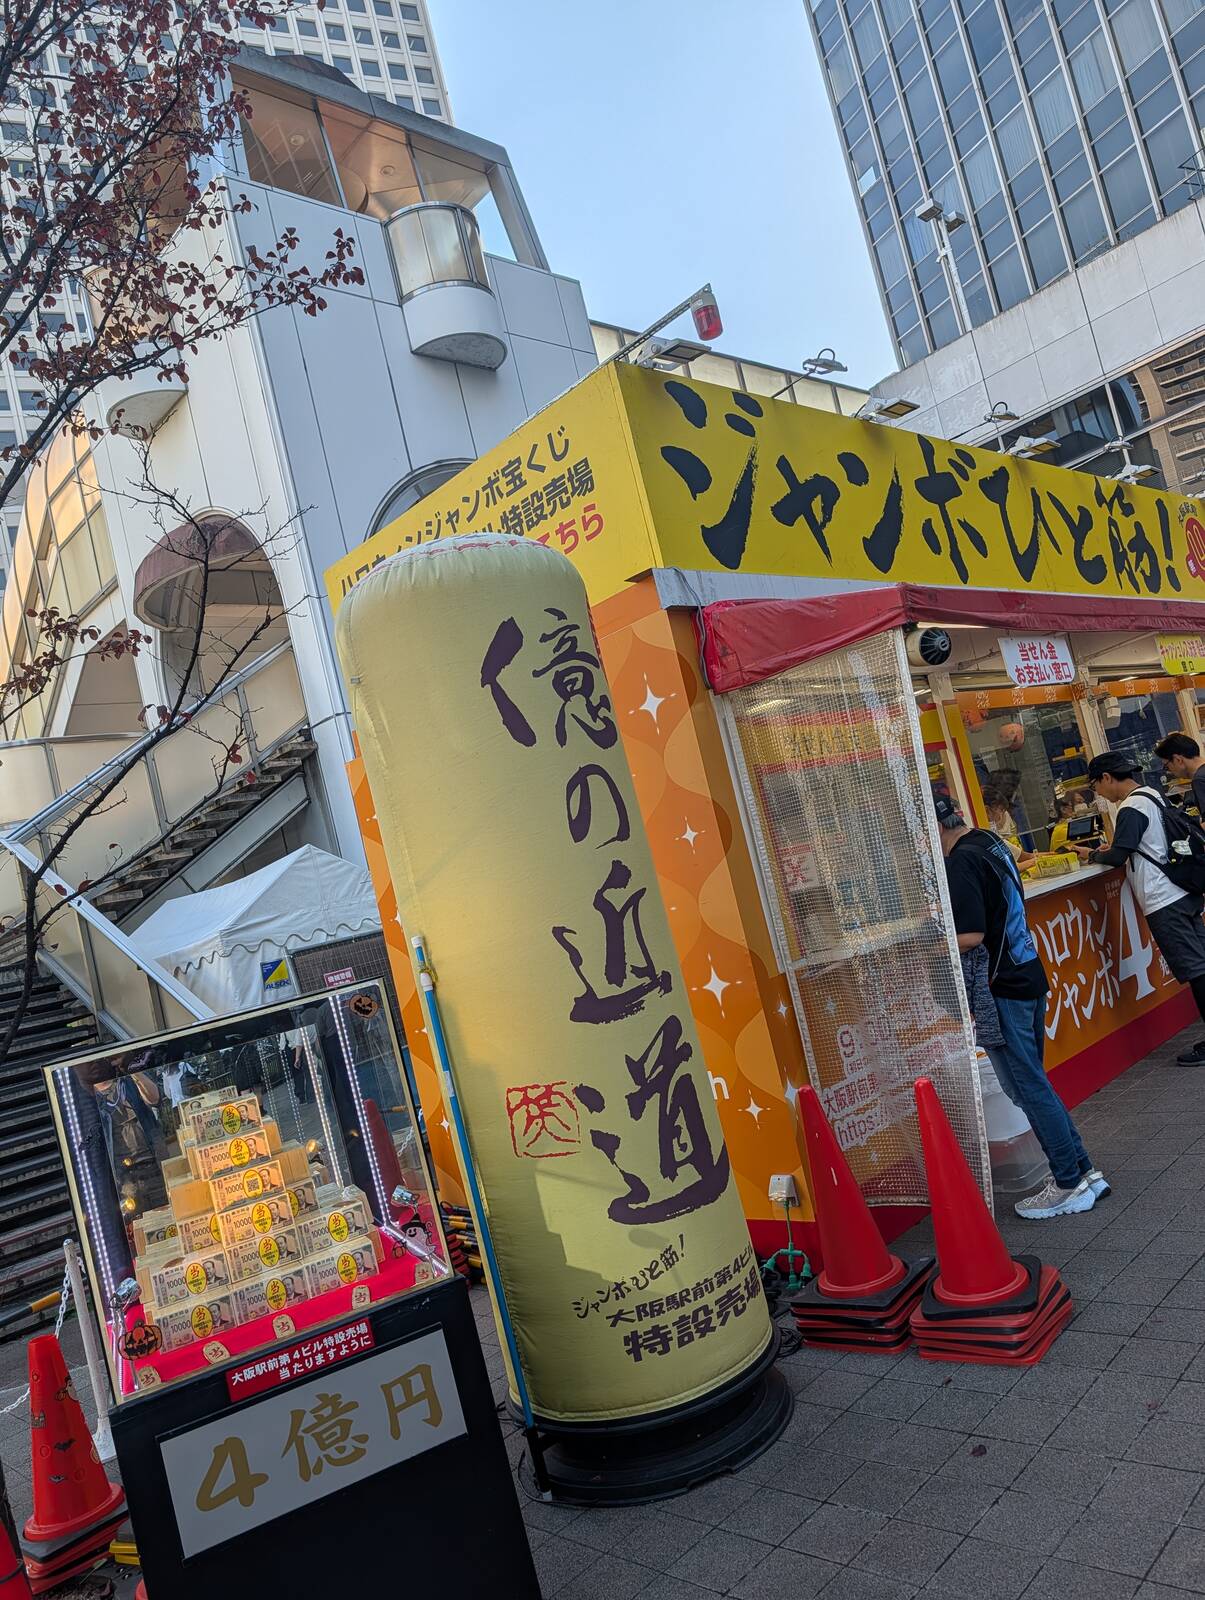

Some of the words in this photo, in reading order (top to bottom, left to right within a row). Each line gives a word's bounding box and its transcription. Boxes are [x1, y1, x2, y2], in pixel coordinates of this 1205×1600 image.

[1017, 641, 1058, 661] 当せん金
[1014, 662, 1073, 684] お支払い窓口
[623, 1265, 761, 1362] 特設売場
[278, 1335, 372, 1381] 当たりますように
